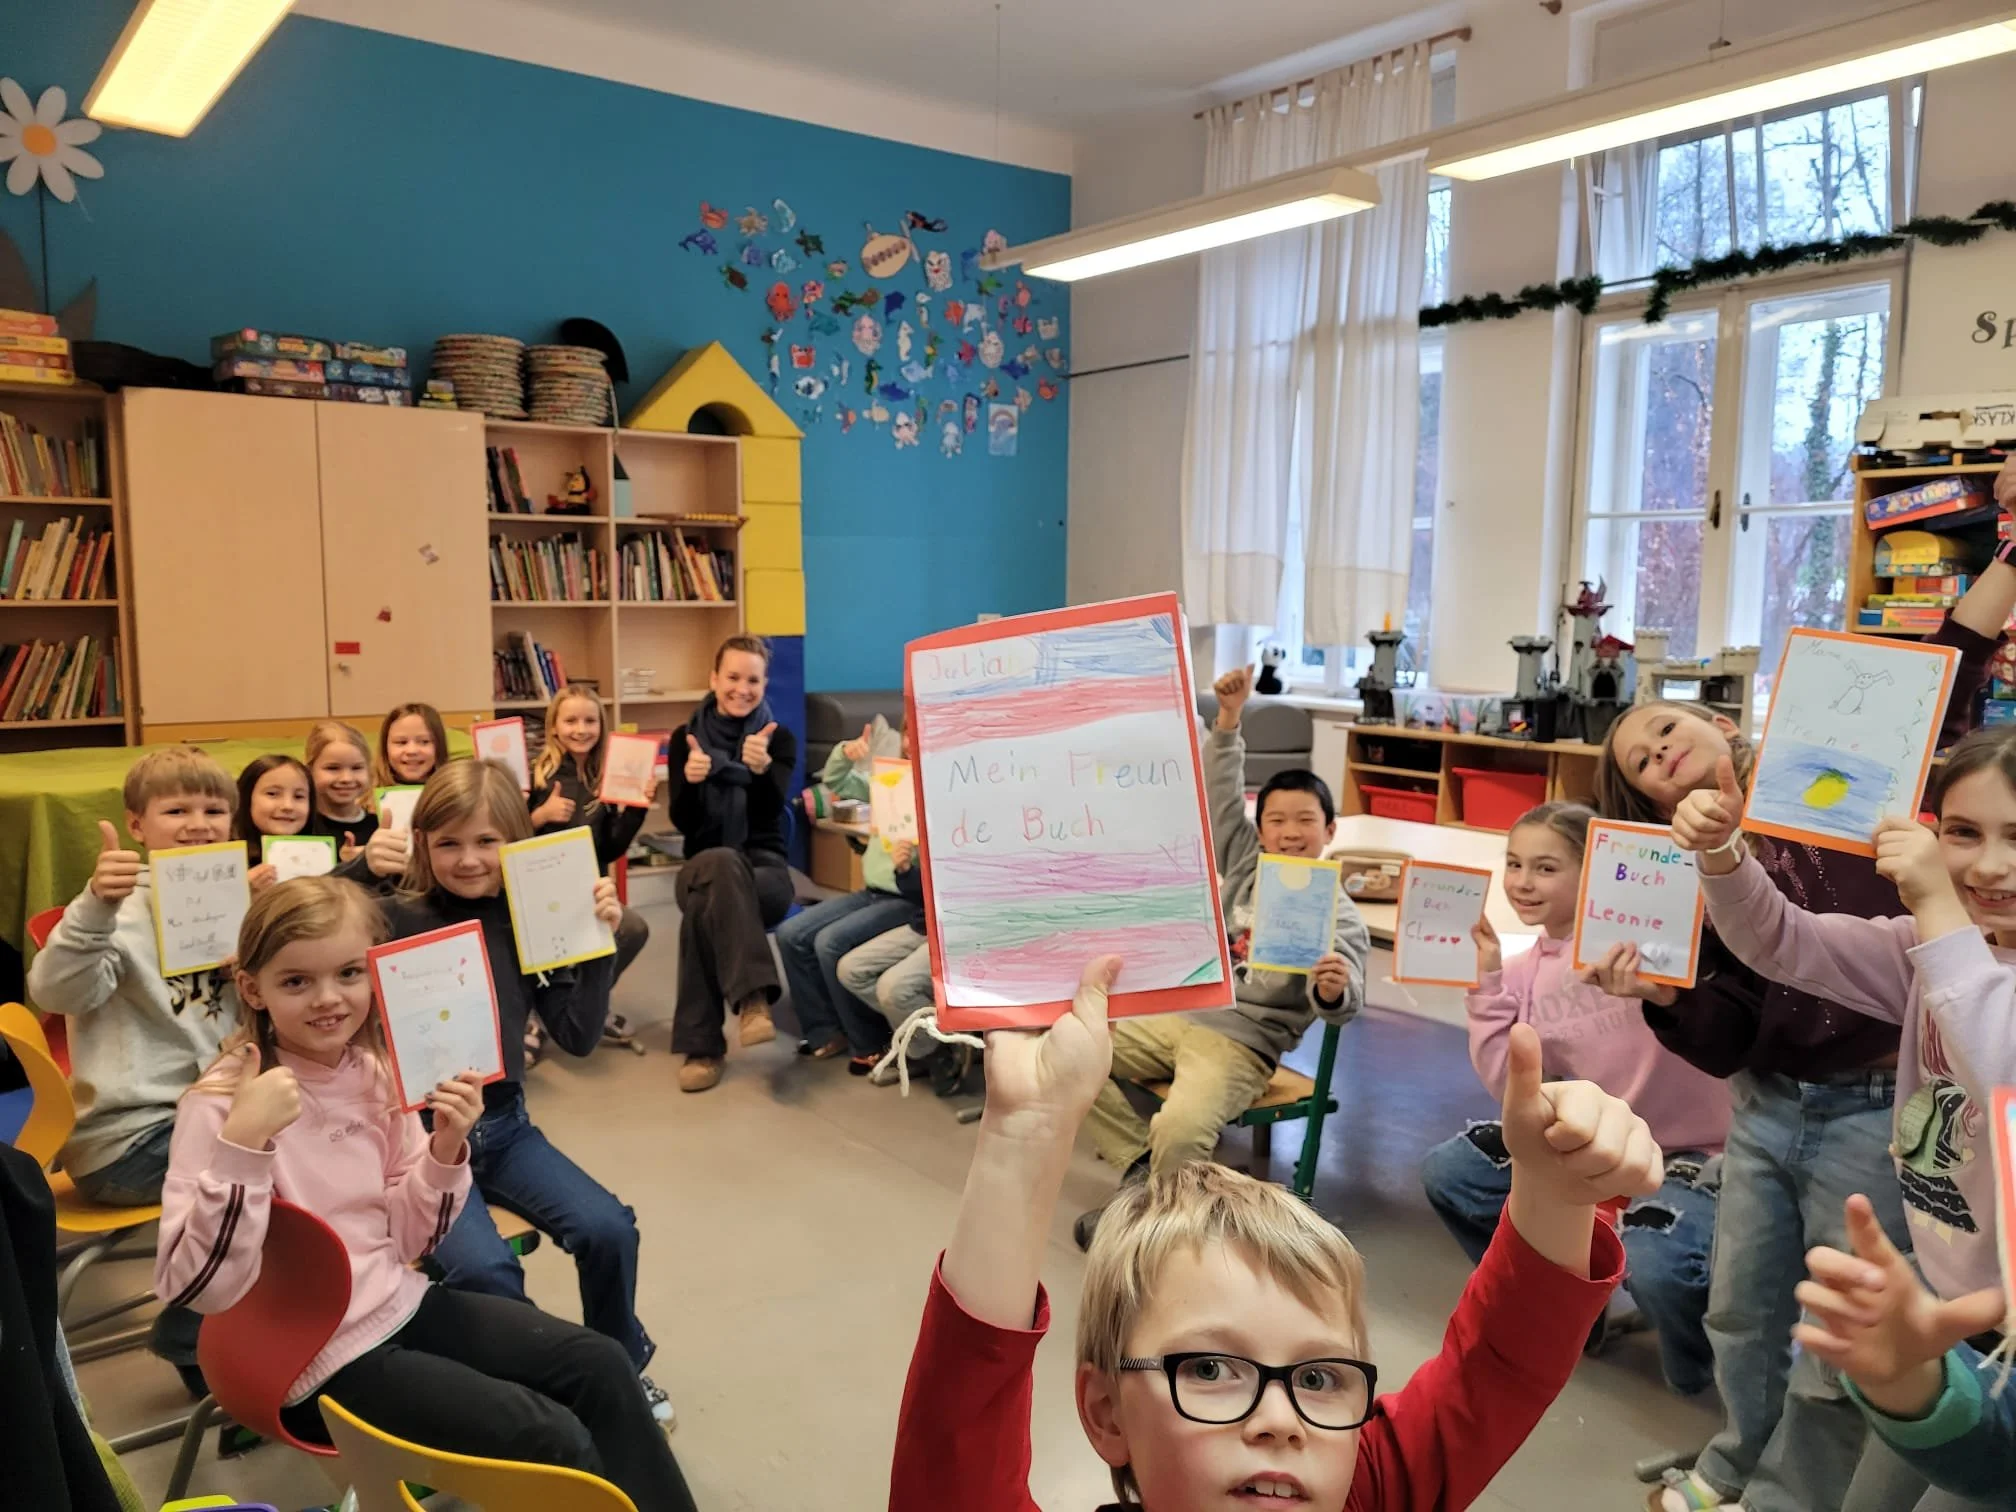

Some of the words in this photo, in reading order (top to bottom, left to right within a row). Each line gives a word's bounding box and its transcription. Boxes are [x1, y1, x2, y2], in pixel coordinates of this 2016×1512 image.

[948, 750, 1038, 792] Mein
[1068, 750, 1183, 788] Freun
[951, 807, 992, 848] de
[1021, 803, 1105, 843] Buch
[1614, 861, 1666, 886] Buch
[1587, 902, 1665, 931] Leonie
